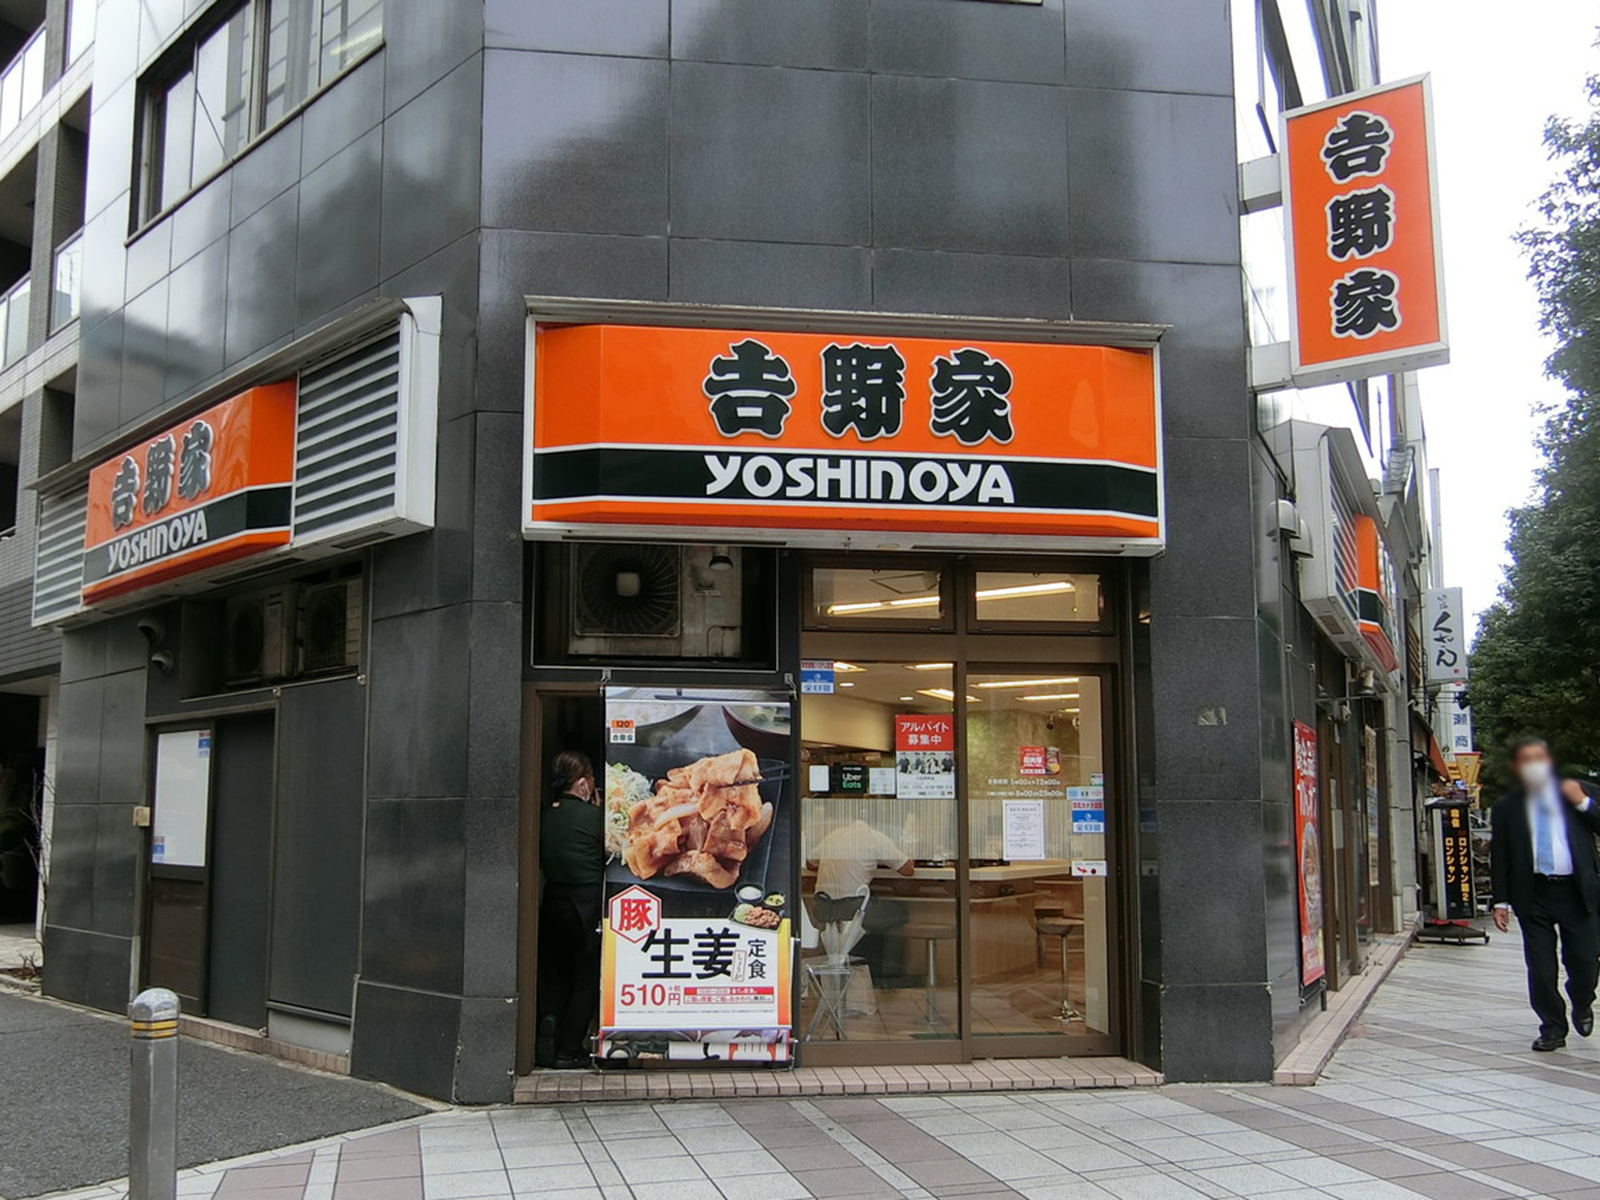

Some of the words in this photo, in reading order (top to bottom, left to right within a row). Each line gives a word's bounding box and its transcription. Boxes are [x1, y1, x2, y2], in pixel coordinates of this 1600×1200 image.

[704, 455, 1015, 504] YOSHINOYA
[108, 510, 207, 573] YOSHINOYA
[900, 722, 949, 733] アルバイト
[907, 734, 942, 745] 募集中
[842, 773, 862, 781] Uber
[842, 780, 862, 789] Eats
[1445, 837, 1455, 883] ロンシャン
[618, 898, 652, 932] 豚
[641, 927, 740, 979] 生姜
[748, 939, 766, 979] 定食
